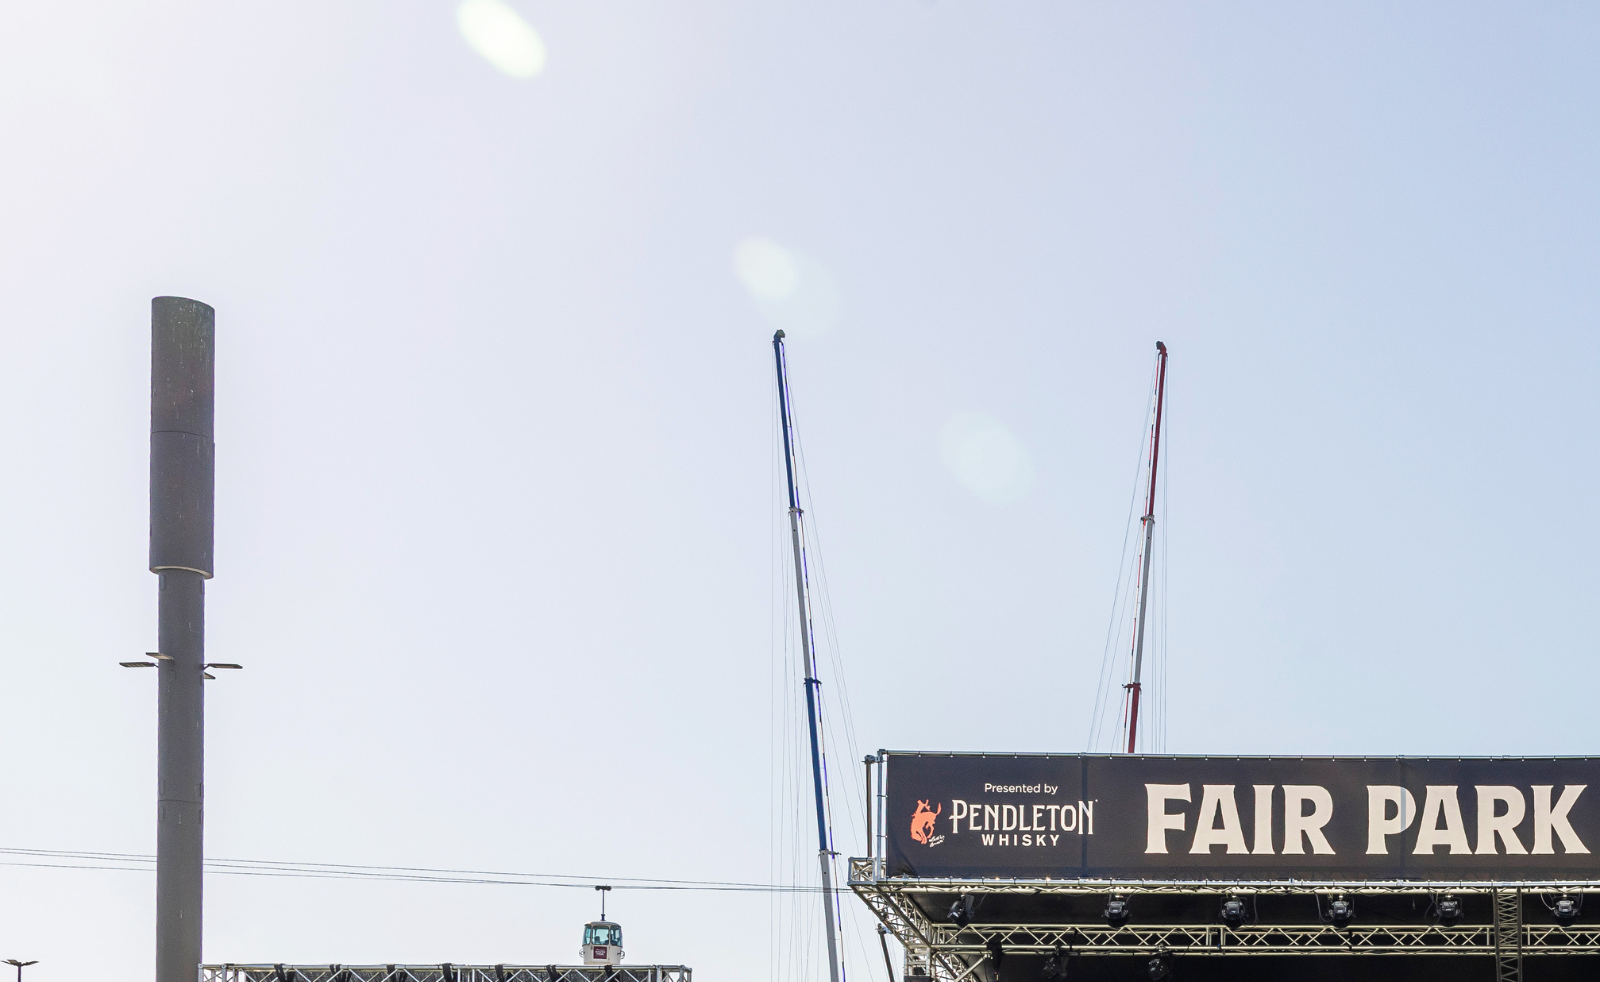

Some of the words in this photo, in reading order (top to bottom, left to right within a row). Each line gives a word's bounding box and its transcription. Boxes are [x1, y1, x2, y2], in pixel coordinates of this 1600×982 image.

[985, 782, 1041, 794] Presented
[1043, 783, 1059, 796] by
[949, 799, 1095, 836] PENDLETON
[1145, 782, 1337, 855] FAIR
[1366, 783, 1592, 855] PARK
[981, 833, 1060, 847] WHISKY
